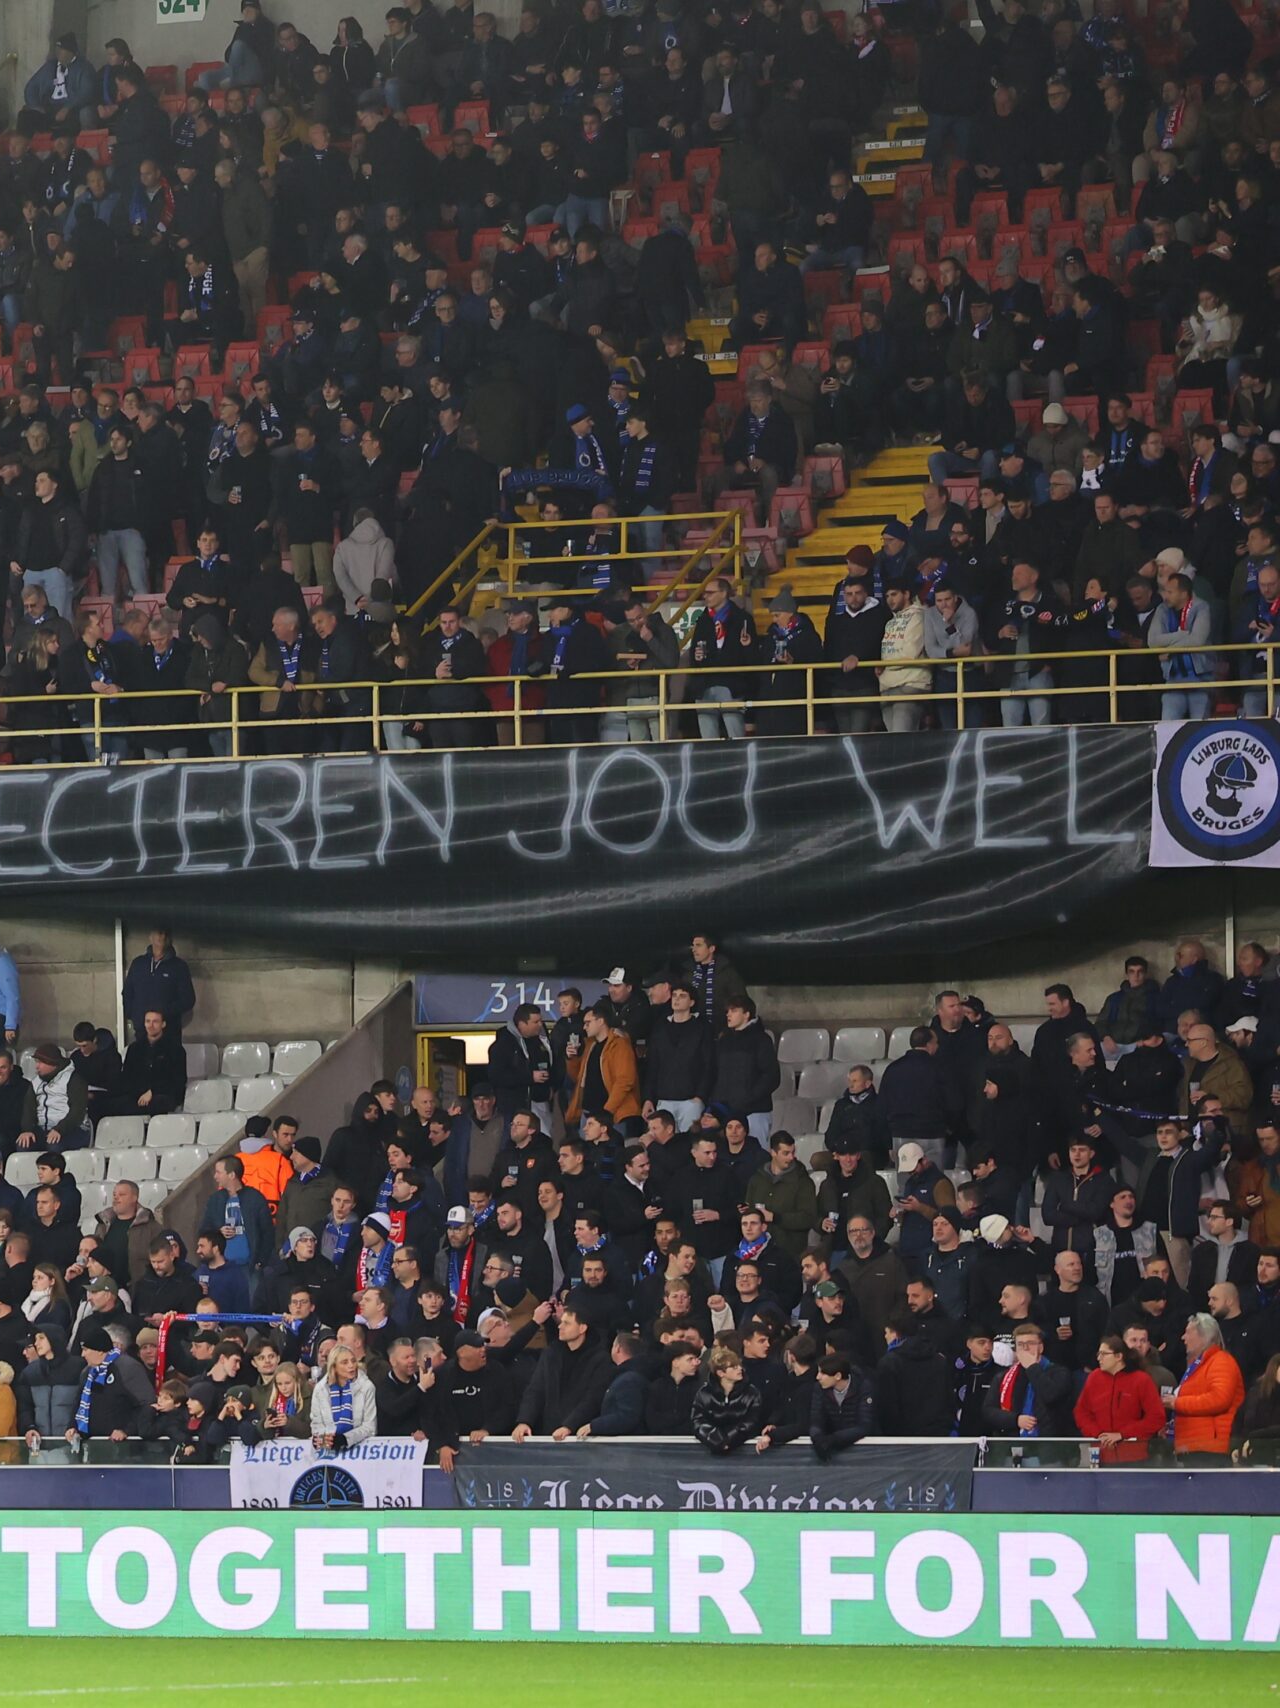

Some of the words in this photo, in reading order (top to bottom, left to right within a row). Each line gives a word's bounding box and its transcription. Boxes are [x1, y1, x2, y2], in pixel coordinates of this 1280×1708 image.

[1191, 738, 1241, 766] LIMBURG
[1242, 739, 1271, 765] LADS
[507, 742, 757, 859] JOU
[843, 726, 1137, 850] WEL
[1191, 806, 1265, 830] BRUGES
[489, 981, 555, 1014] 314
[295, 1471, 324, 1502] BRUGES
[333, 1471, 359, 1497] ELITE
[0, 1525, 763, 1635] TOGETHER
[799, 1529, 1098, 1639] FOR
